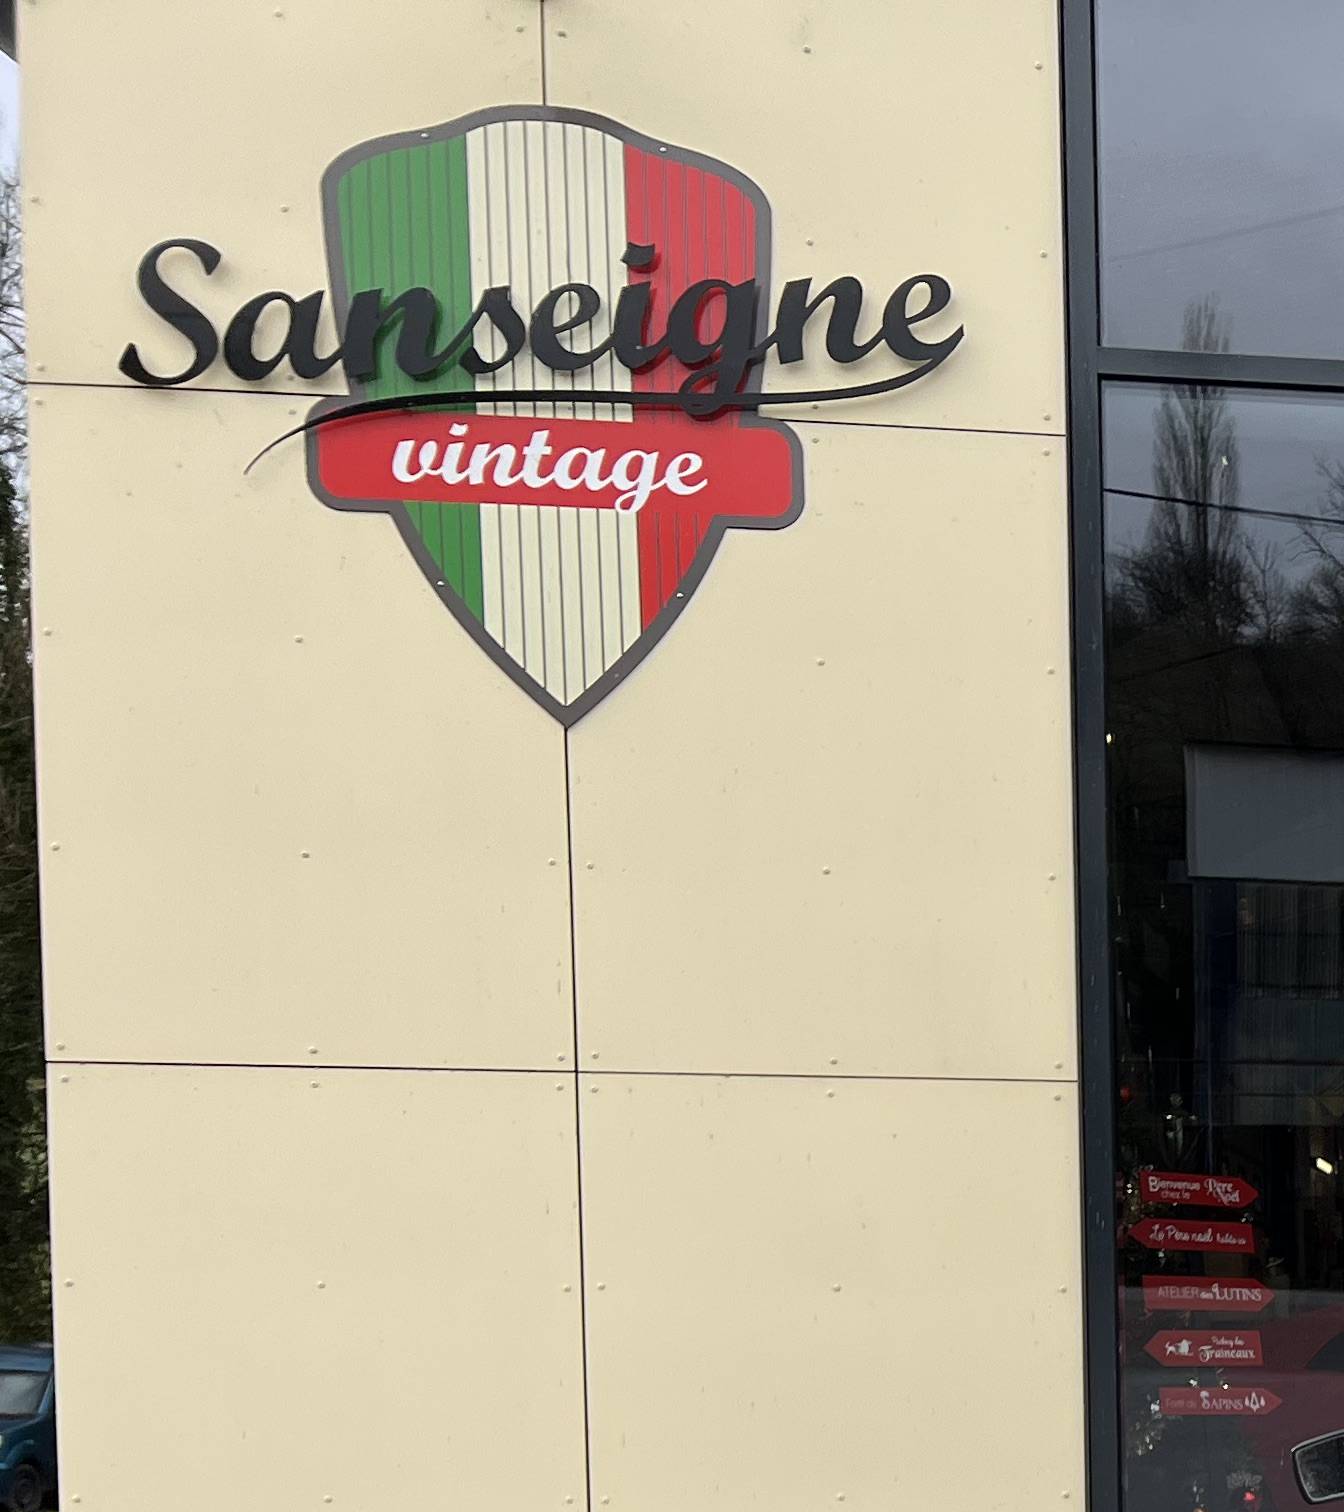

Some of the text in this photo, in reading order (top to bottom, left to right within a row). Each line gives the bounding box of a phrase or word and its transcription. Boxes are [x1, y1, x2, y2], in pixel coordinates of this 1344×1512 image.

[118, 238, 963, 420] Sanseigne
[391, 422, 708, 513] vintage
[1158, 1286, 1199, 1299] ATELIER
[1212, 1283, 1262, 1301] LUTINS
